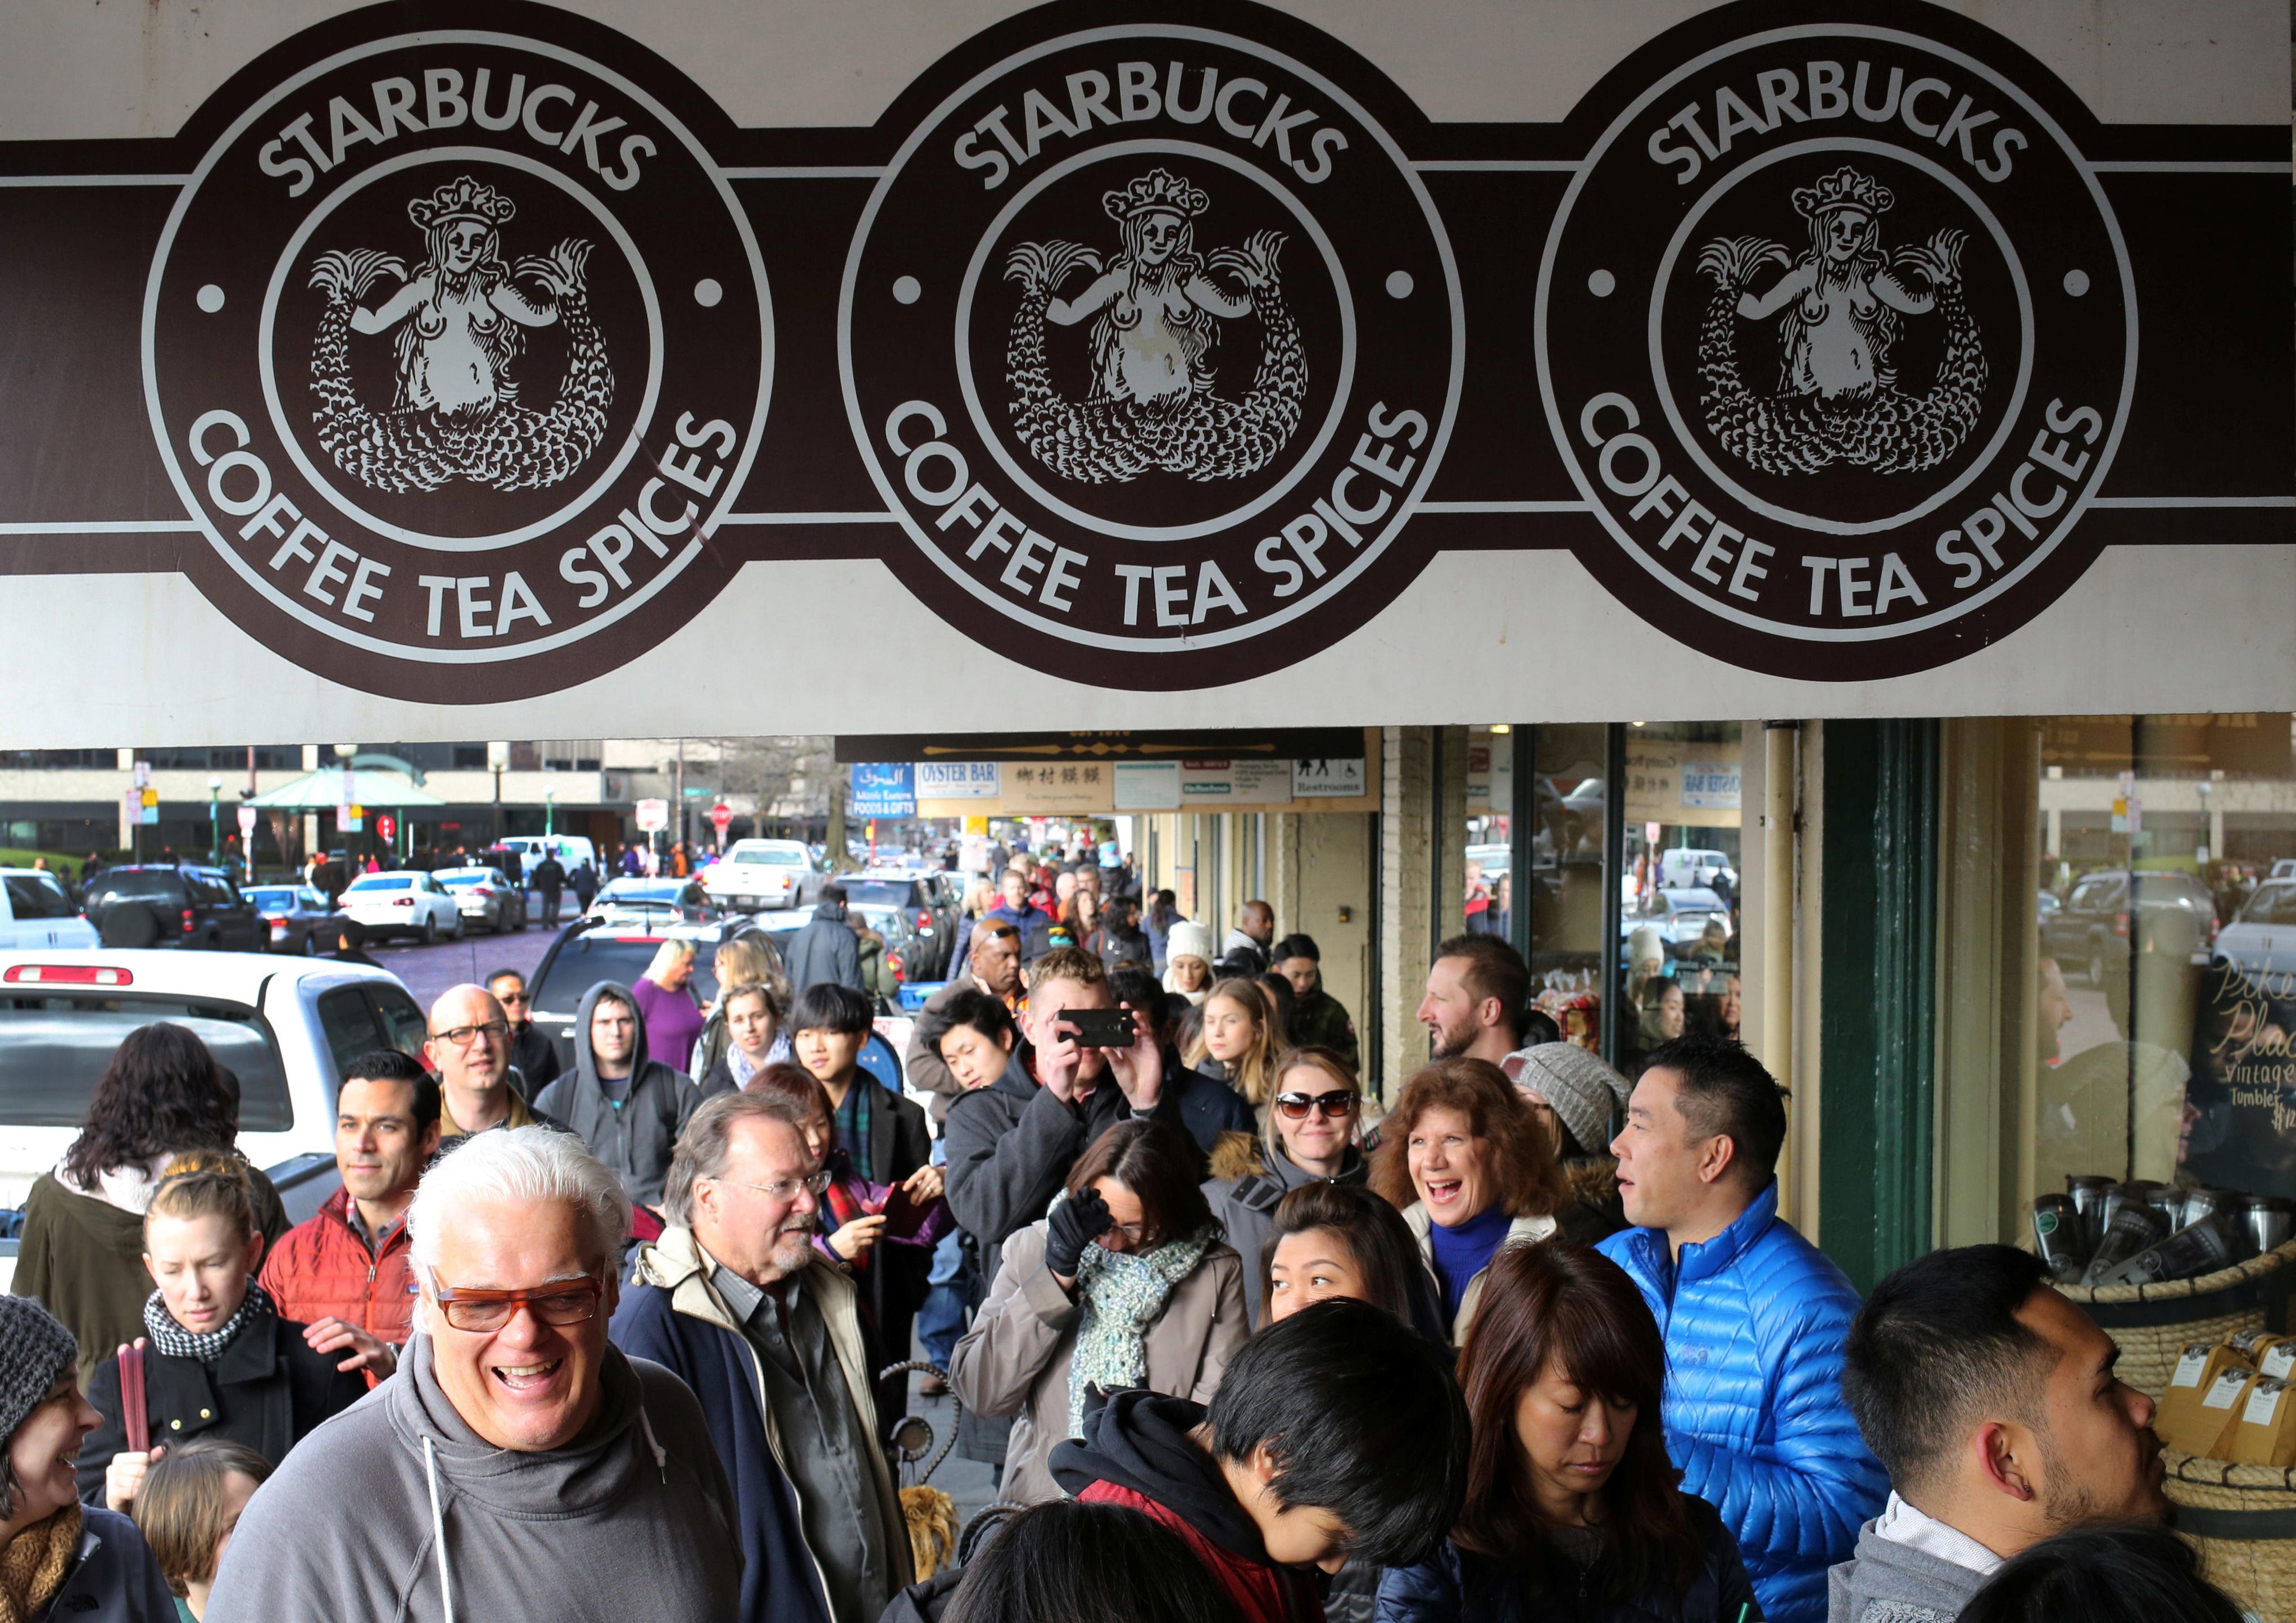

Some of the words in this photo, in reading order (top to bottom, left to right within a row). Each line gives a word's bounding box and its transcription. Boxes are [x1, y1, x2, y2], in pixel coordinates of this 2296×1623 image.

[259, 68, 657, 197] STARBUCKS
[954, 61, 1348, 189] STARBUCKS
[1648, 61, 2028, 185] STARBUCKS
[189, 410, 391, 622] COFFEE
[419, 572, 552, 637] TEA
[560, 411, 736, 608] SPICES
[886, 401, 1088, 613] COFFEE
[1115, 560, 1248, 627] TEA
[1254, 401, 1428, 597] SPICES
[1581, 392, 1775, 602] COFFEE
[1802, 552, 1928, 616] TEA
[1936, 398, 2102, 588] SPICES
[712, 810, 731, 819] STOP
[854, 802, 882, 815] FOODS
[883, 802, 890, 814] &
[890, 802, 914, 815] GIFTS
[923, 764, 965, 782] OYSTER
[971, 764, 994, 781] BAR
[1298, 782, 1359, 792] Restrooms
[2212, 956, 2296, 1004] Pike
[2229, 1087, 2284, 1108] Tumbler
